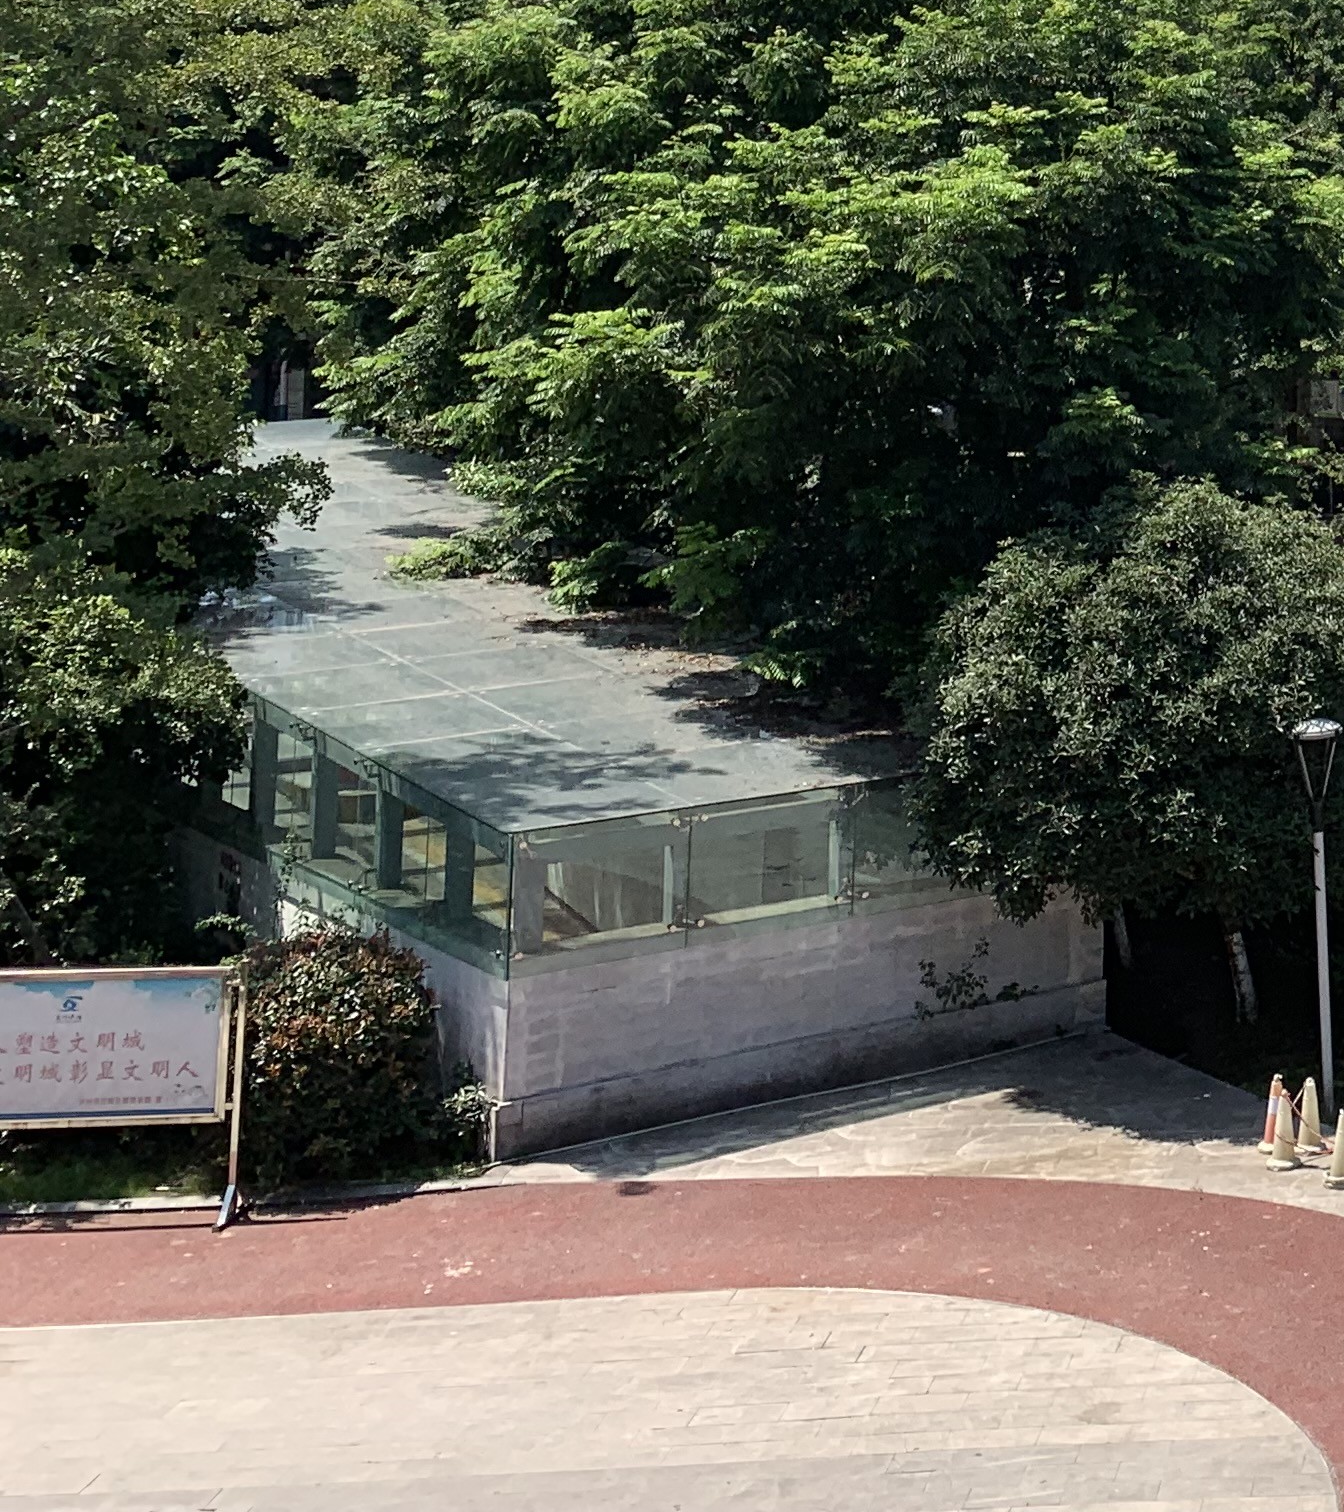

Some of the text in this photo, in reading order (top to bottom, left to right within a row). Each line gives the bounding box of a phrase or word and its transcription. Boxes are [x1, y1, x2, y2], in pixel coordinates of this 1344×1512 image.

[0, 1030, 145, 1055] 塑造文明城
